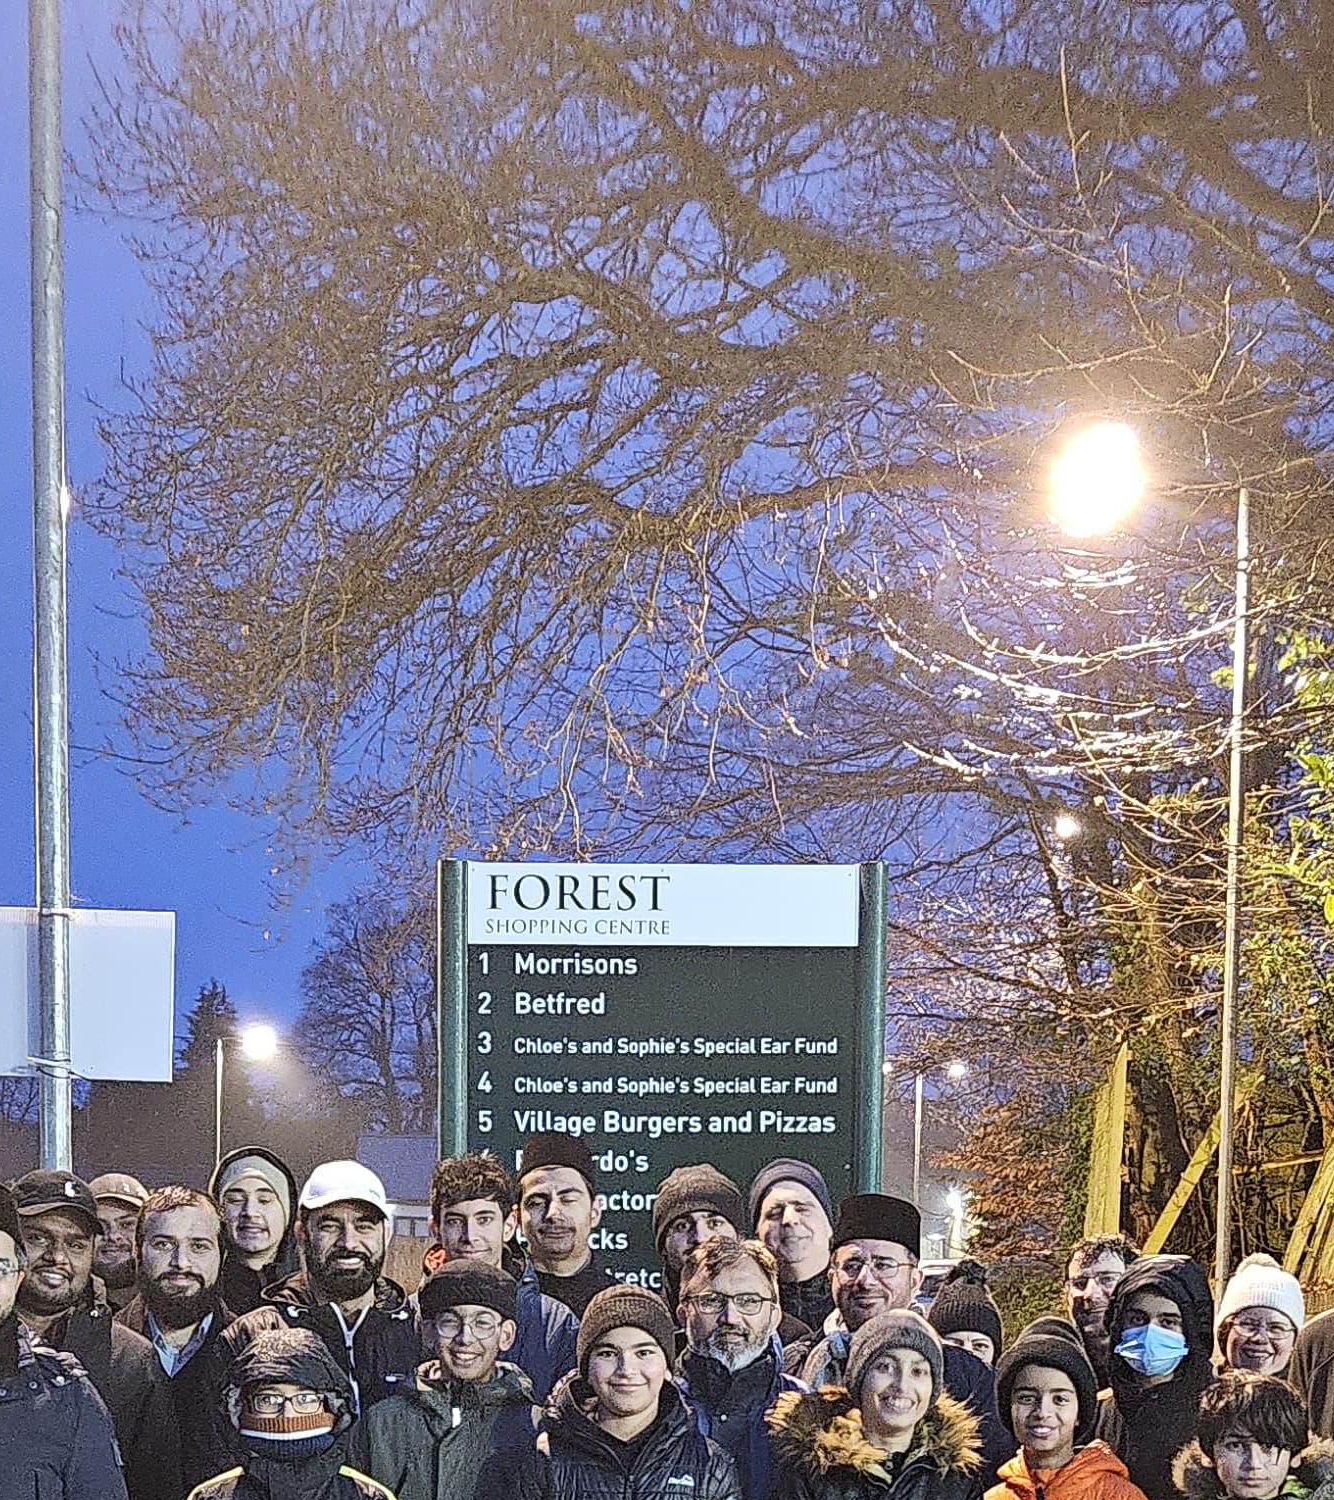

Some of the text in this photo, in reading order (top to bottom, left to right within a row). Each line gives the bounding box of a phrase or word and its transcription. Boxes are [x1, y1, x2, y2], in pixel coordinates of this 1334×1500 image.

[485, 874, 671, 912] FOREST
[484, 918, 671, 936] SHOPPING CENTRE
[478, 952, 638, 975] 1 Morrisons
[477, 992, 605, 1015] 2 Betfred
[477, 1031, 838, 1057] 3 Chloe's and Sophie's Special Ear Fund
[477, 1071, 838, 1097] 4 Chloe's and Sophie's Special Ear Fund
[478, 1110, 836, 1138] 5 Village Burgers and Pizzas
